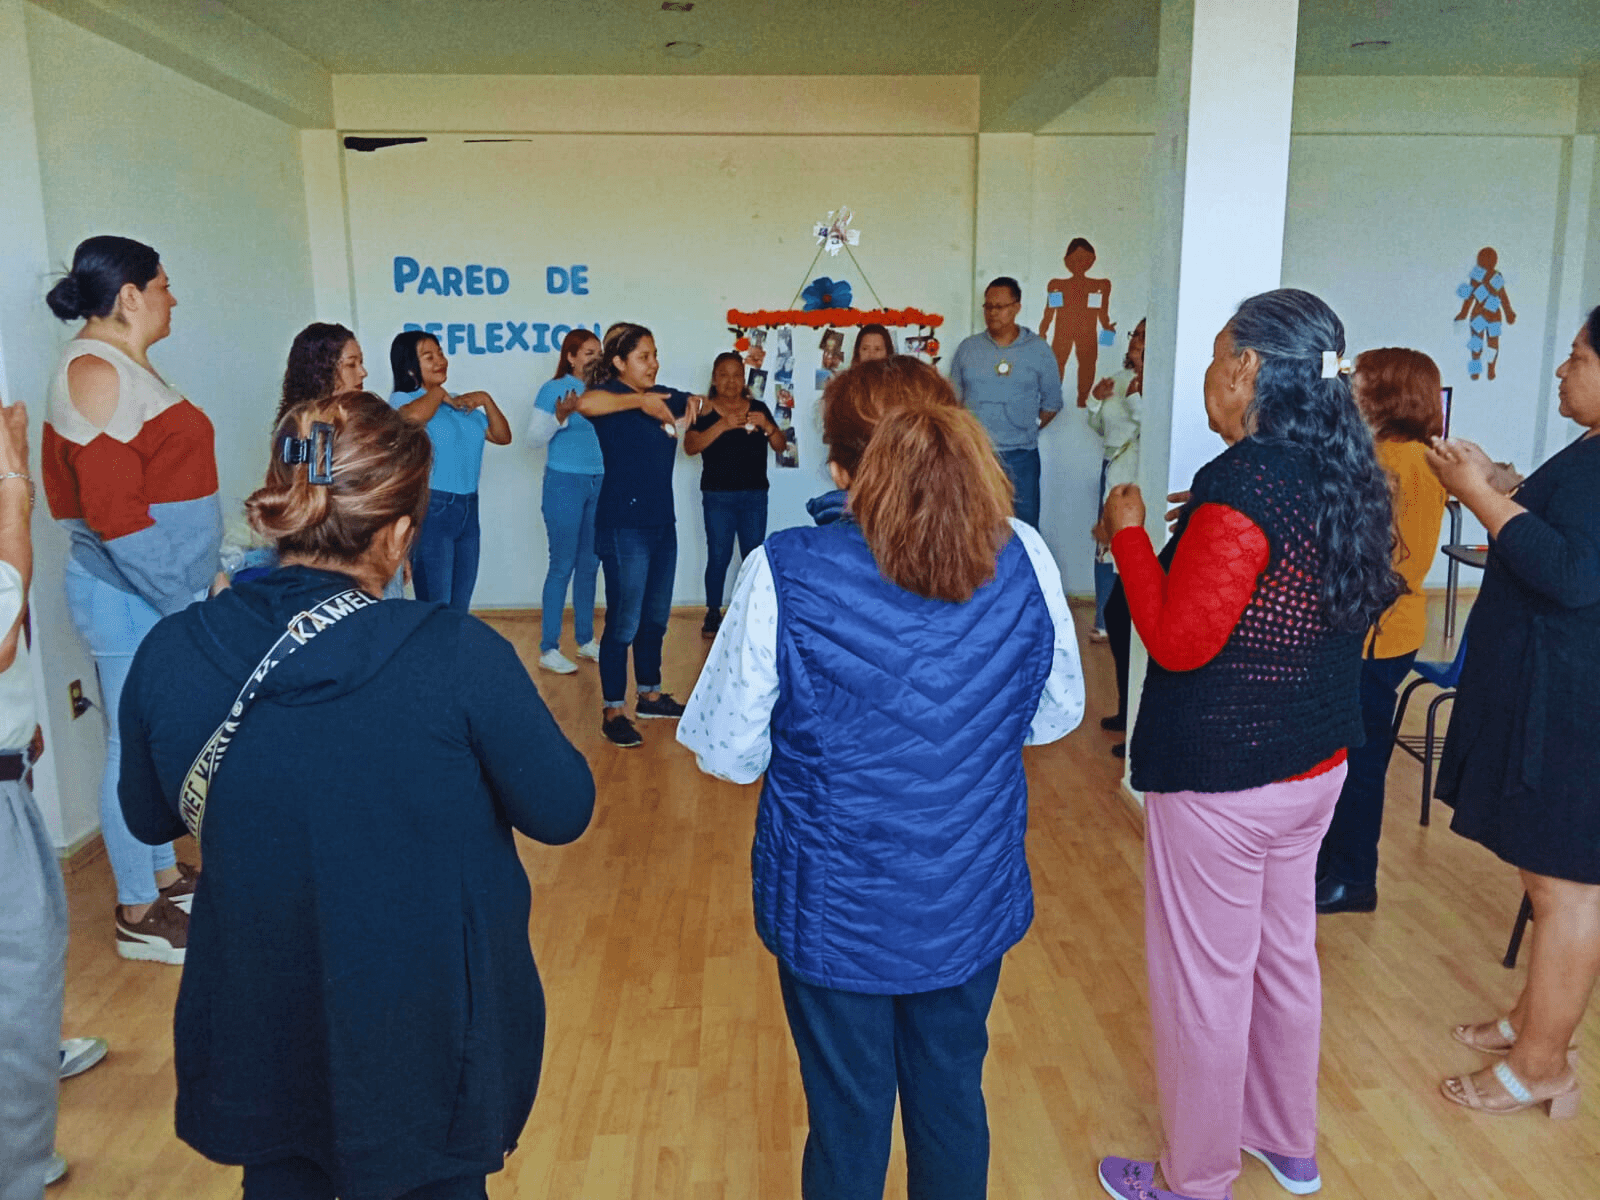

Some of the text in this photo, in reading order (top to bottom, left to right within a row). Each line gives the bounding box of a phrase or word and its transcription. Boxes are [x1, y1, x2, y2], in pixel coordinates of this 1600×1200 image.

[393, 256, 589, 296] PARED DE
[403, 321, 601, 355] FLEXIO
